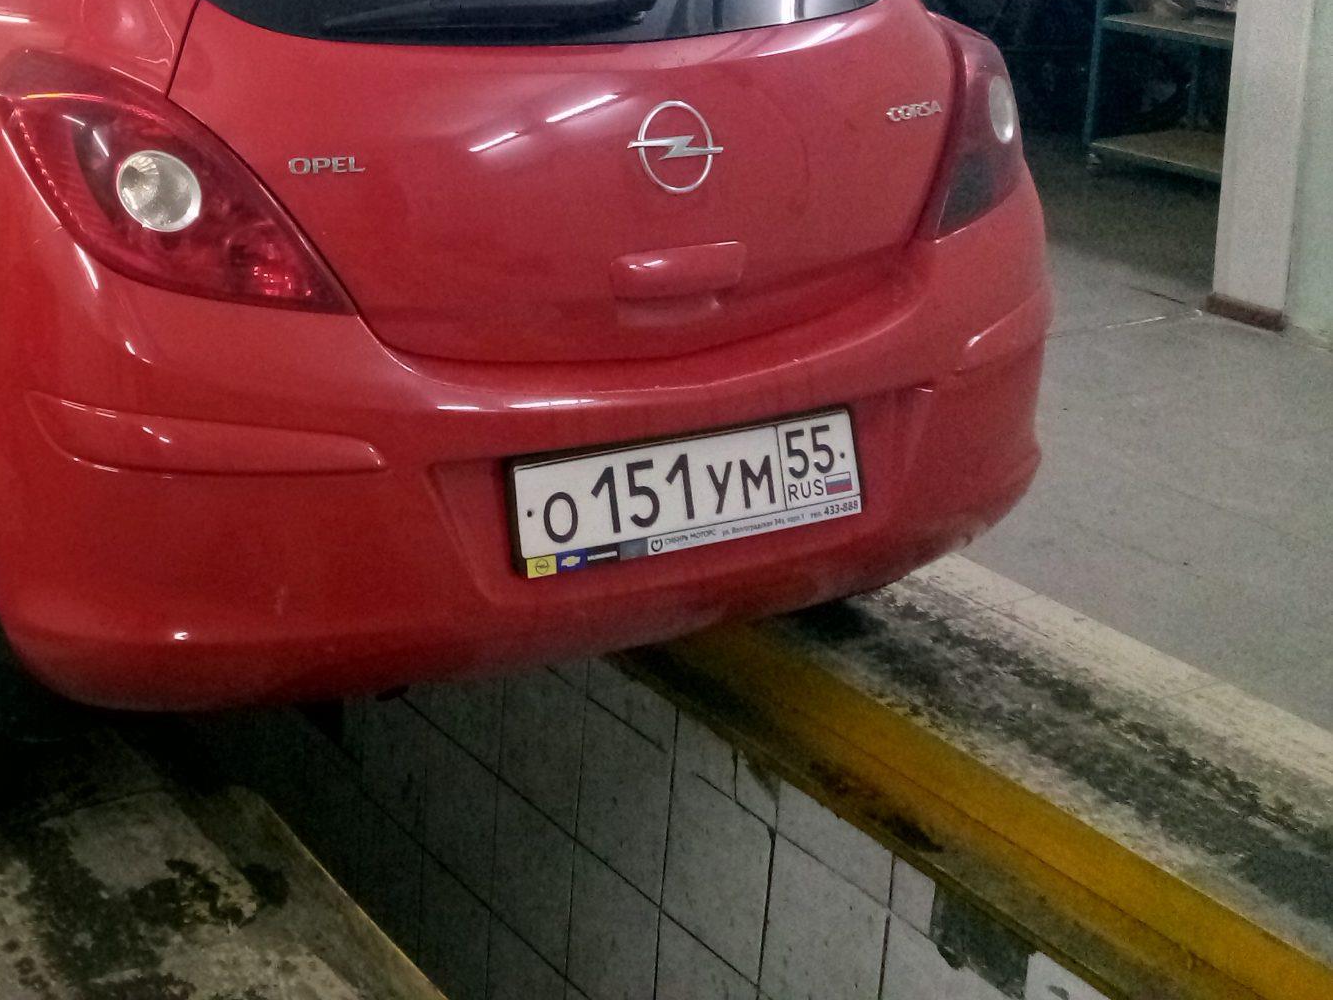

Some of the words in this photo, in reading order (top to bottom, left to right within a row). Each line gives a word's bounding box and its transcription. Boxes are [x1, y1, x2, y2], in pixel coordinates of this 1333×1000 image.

[887, 100, 942, 122] CORSA
[288, 155, 365, 175] OPEL
[785, 424, 835, 479] 55
[788, 476, 825, 502] RUS
[823, 500, 859, 516] 433-888
